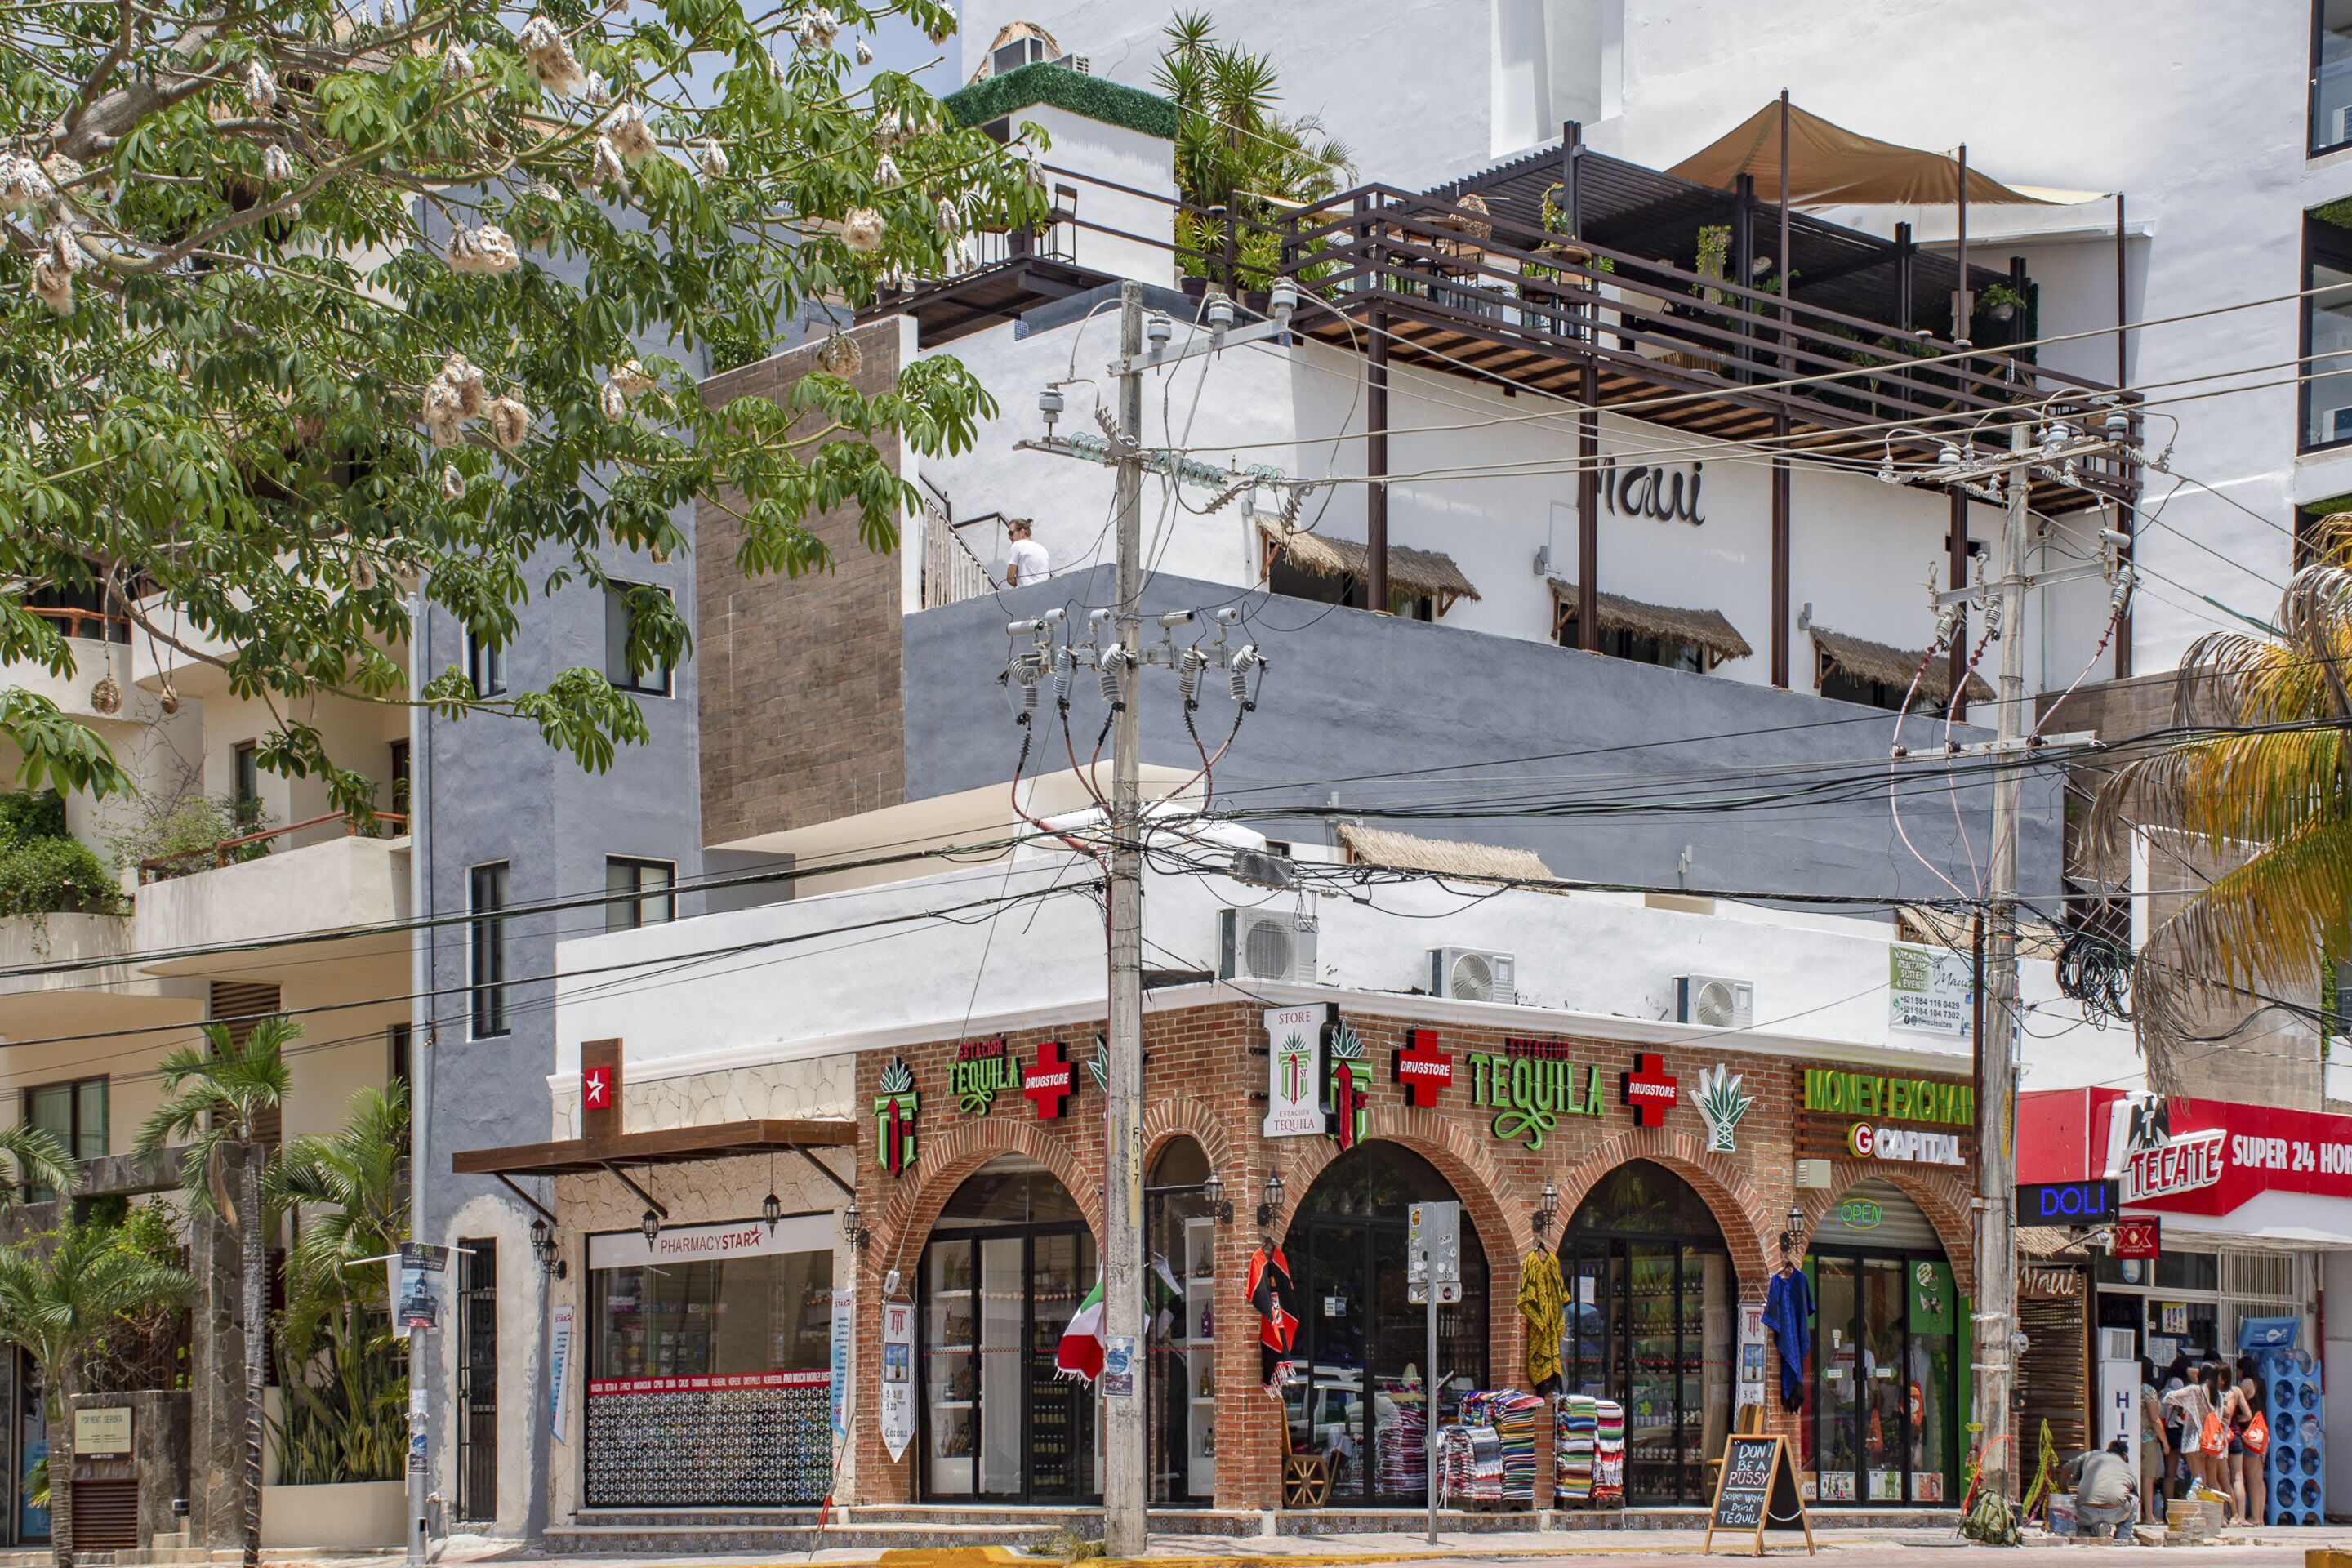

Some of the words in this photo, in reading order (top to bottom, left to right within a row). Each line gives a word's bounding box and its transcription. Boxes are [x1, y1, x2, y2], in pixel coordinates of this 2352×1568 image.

[1898, 960, 1927, 971] RENTALS
[1901, 969, 1924, 979] SUITES
[1930, 999, 1941, 1007] 116
[1944, 1000, 1959, 1009] 0429
[1279, 1011, 1311, 1025] STORE
[1944, 1010, 1959, 1020] 7302
[1400, 1060, 1450, 1076] DRUGSTORE
[947, 1056, 1019, 1115] TEQUILA
[1025, 1072, 1069, 1089] DRUGSTORE
[1629, 1082, 1676, 1098] DRUGSTORE
[1804, 1068, 1886, 1116] MONEY
[1469, 1054, 1605, 1150] TEQUILA
[1274, 1118, 1315, 1132] TEQUILA
[1874, 1128, 1966, 1166] CAPITAL
[2232, 1134, 2287, 1170] SUPER
[2292, 1141, 2315, 1172] 24
[2320, 1143, 2352, 1175] HOR
[2125, 1138, 2222, 1195] TECATE
[2041, 1186, 2105, 1216] DOLI
[1840, 1205, 1882, 1222] OPEN
[661, 1232, 751, 1254] PHARMACYSTAR
[2116, 1225, 2152, 1248] XX
[1737, 1460, 1754, 1472] BE
[1756, 1461, 1766, 1471] A
[1728, 1471, 1769, 1486] PUSSY
[1721, 1491, 1741, 1501] Save
[1744, 1492, 1764, 1503] Wate
[1731, 1502, 1754, 1512] Drink
